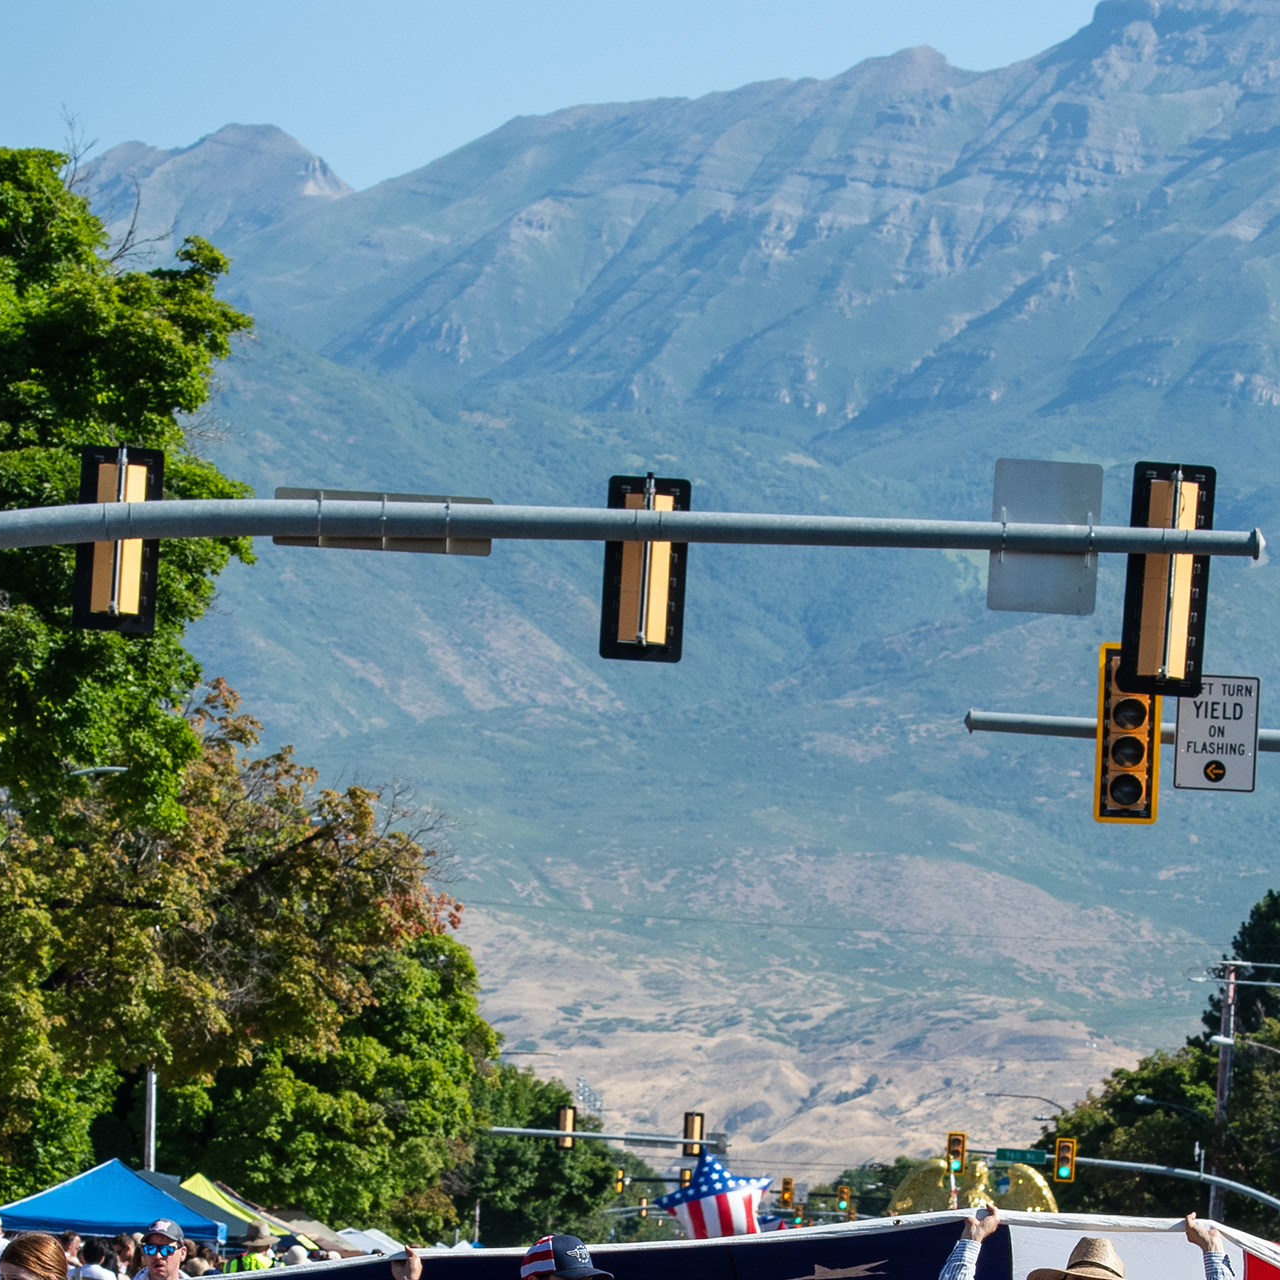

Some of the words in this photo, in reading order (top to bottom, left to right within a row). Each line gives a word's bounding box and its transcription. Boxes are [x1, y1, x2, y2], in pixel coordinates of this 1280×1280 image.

[1200, 683, 1214, 696] FT
[1222, 683, 1253, 698] TURN
[1193, 701, 1244, 720] YIELD
[1208, 724, 1225, 738] ON
[1186, 741, 1246, 756] FLASHING
